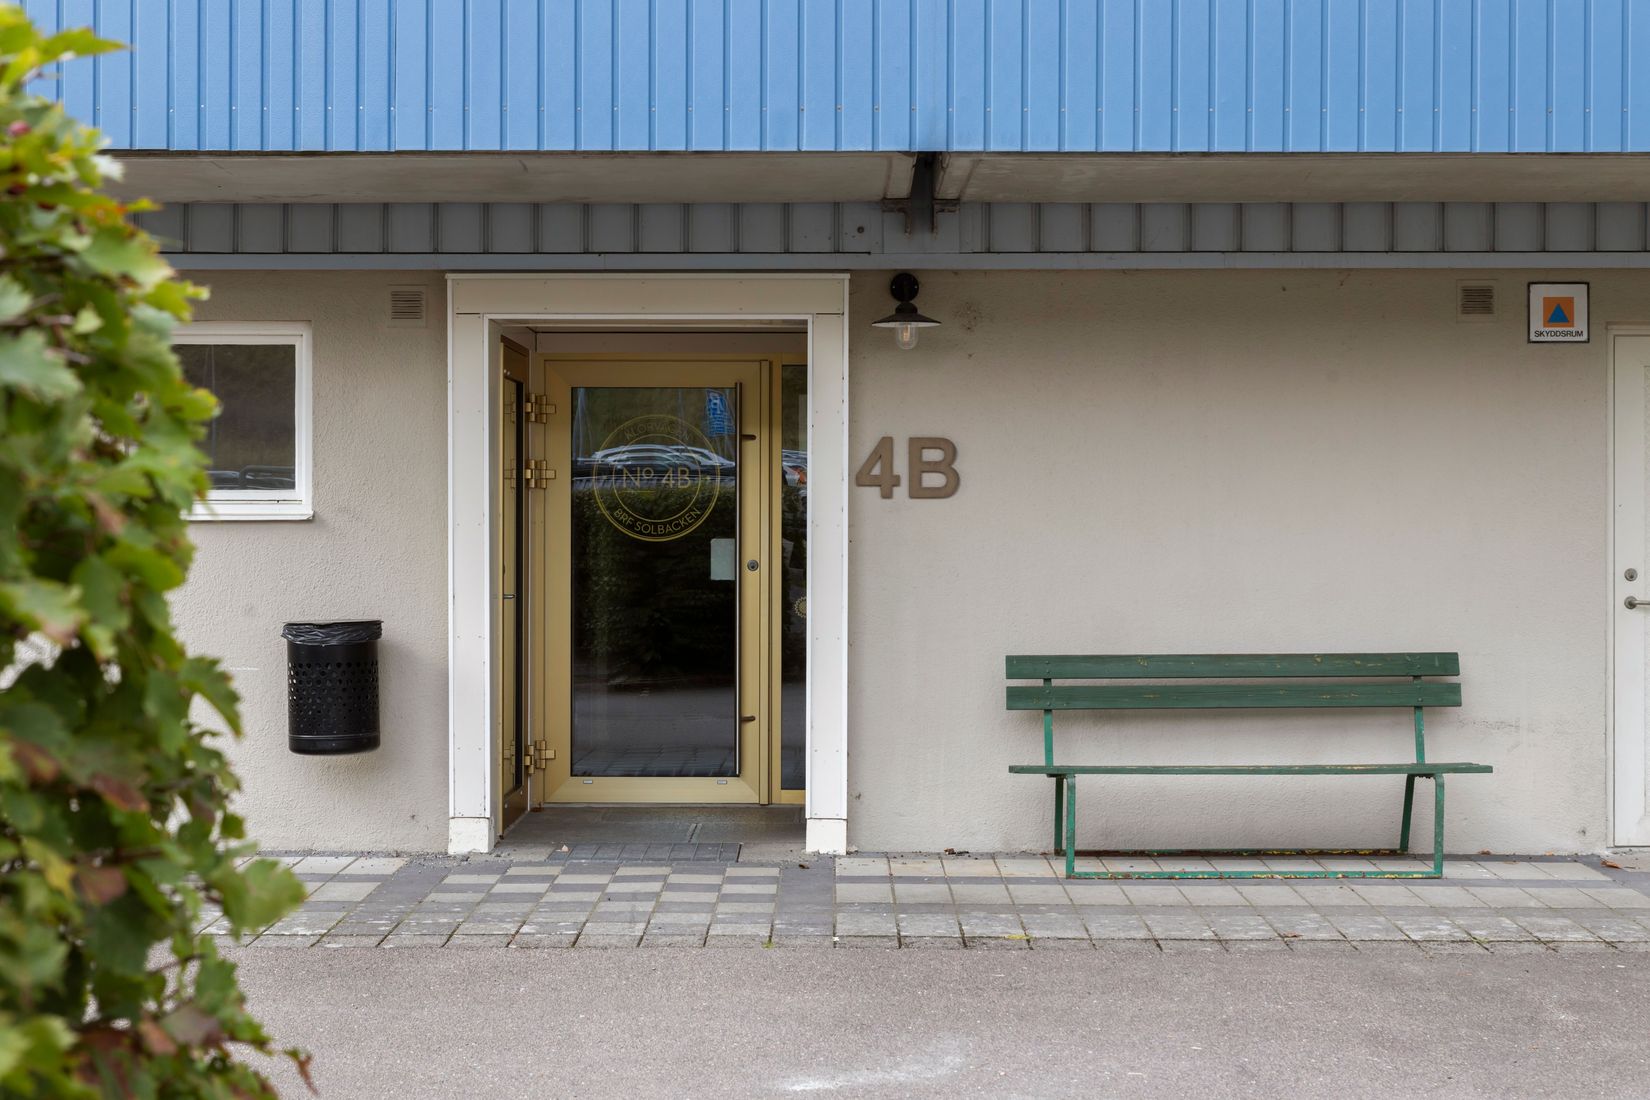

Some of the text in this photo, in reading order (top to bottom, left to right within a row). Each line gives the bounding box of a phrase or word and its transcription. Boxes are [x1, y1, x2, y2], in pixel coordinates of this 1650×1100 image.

[1534, 330, 1584, 338] SKYDDSRUM
[661, 466, 691, 489] 4B
[855, 436, 960, 499] 4B
[613, 507, 702, 535] BRF SOLBACKEN
